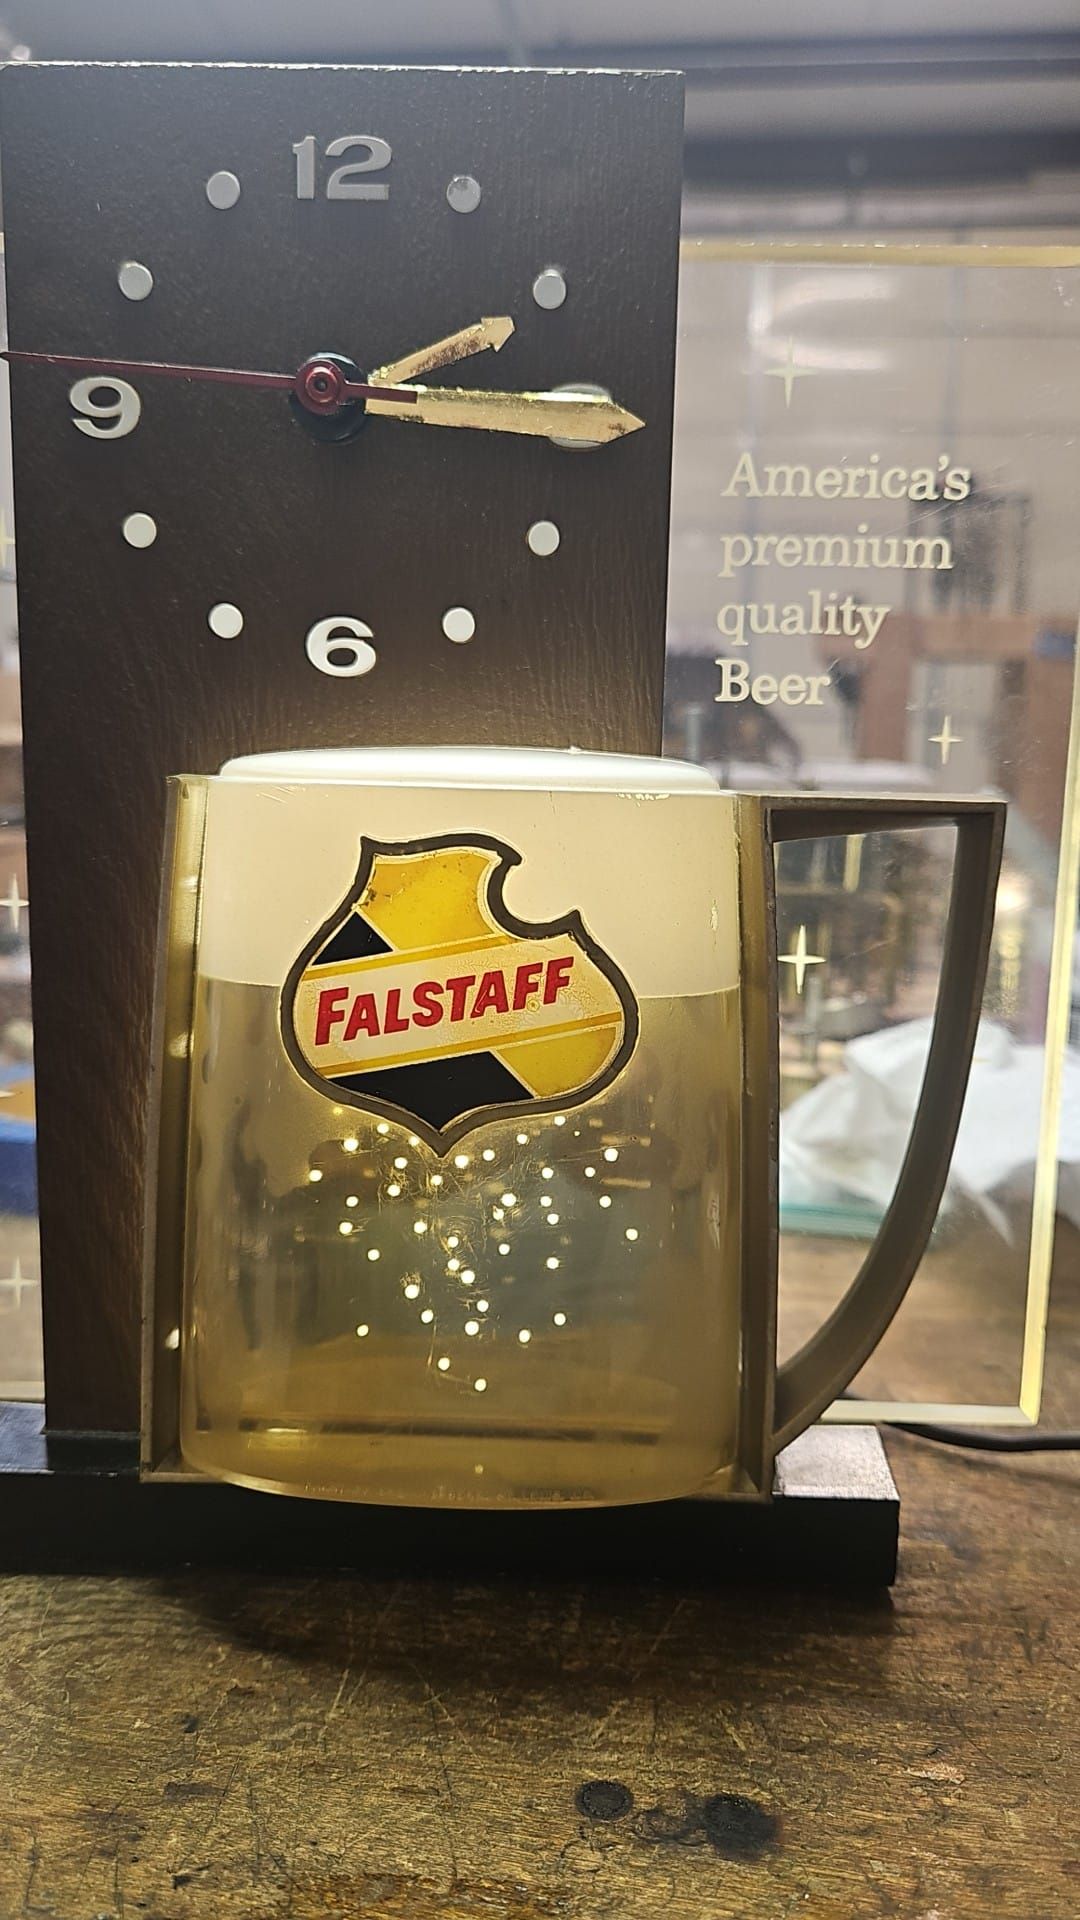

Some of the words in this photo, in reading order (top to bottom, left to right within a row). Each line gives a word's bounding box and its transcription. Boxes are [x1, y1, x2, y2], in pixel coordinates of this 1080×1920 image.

[292, 134, 393, 201] 12
[69, 376, 142, 440] 9
[719, 451, 972, 501] America's
[717, 522, 954, 578] premium
[305, 616, 377, 678] 6
[716, 589, 890, 649] quality
[714, 658, 832, 706] Beer
[314, 955, 574, 1047] FALSTAFF
